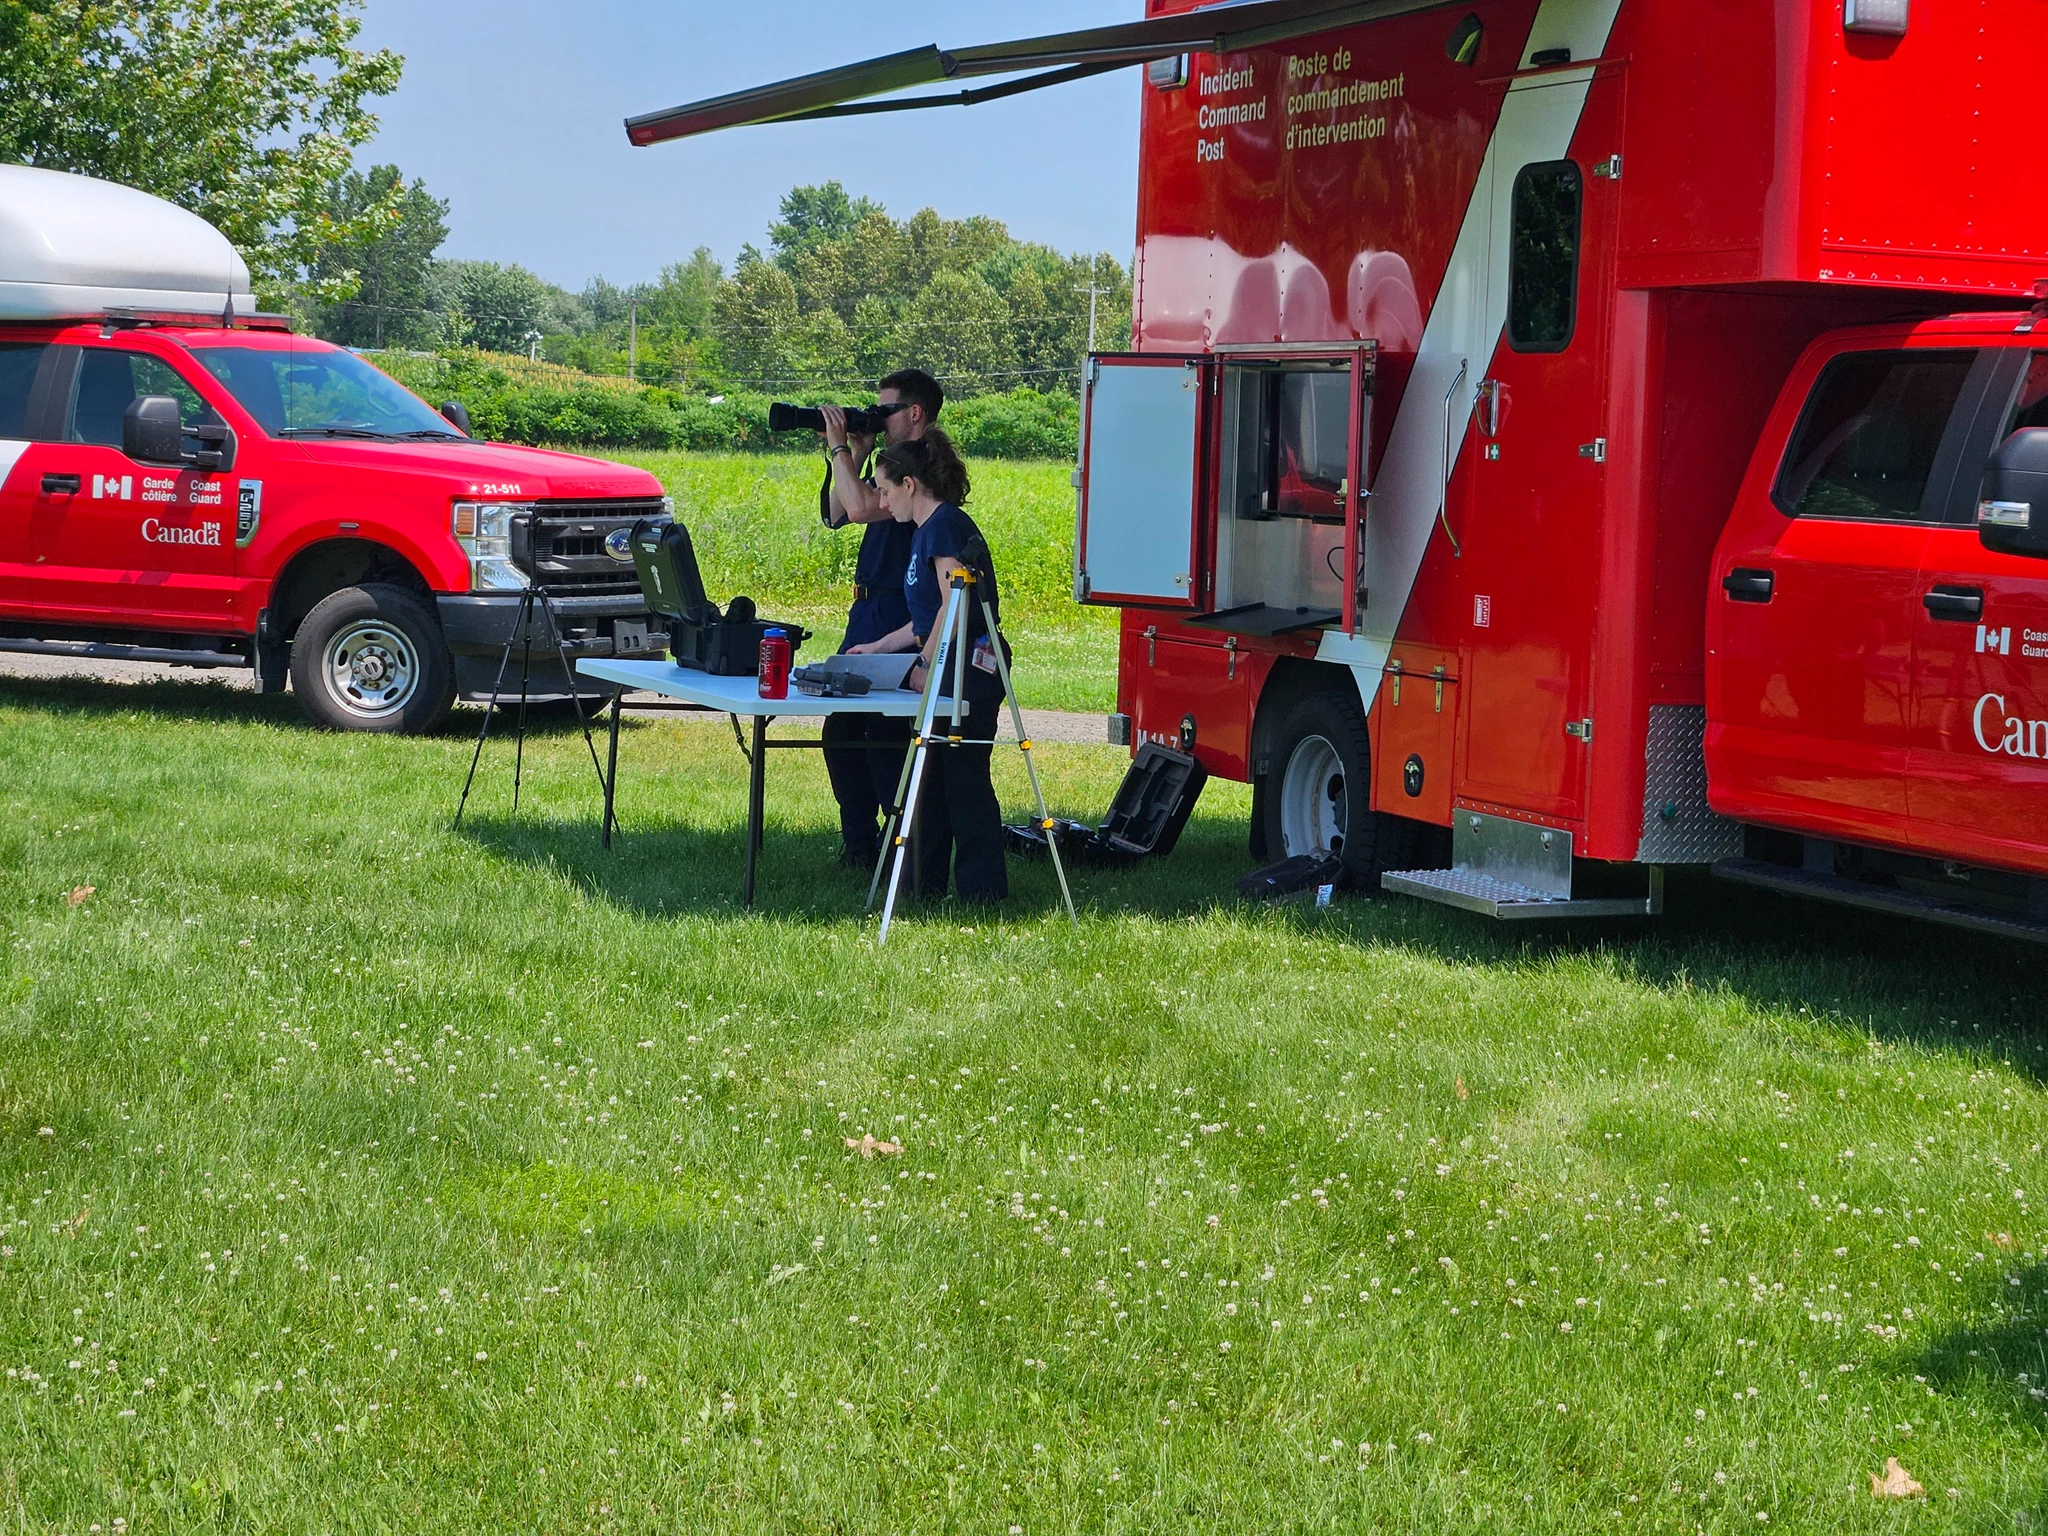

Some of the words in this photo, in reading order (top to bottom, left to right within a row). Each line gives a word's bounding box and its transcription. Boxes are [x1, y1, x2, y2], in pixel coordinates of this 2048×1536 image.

[1288, 53, 1328, 80] Poste
[1333, 46, 1352, 72] de
[1200, 64, 1254, 96] Incident
[1287, 72, 1405, 116] commandement
[1199, 95, 1267, 130] Command
[1286, 113, 1386, 150] d'intervention
[1197, 137, 1225, 163] Post
[143, 476, 175, 489] Garde
[190, 479, 221, 492] Coast
[483, 484, 521, 494] 21-511
[142, 489, 177, 502] côtière
[189, 492, 221, 504] Guard
[141, 518, 221, 546] Canada
[2022, 628, 2048, 642] Coas
[1137, 728, 1148, 751] M
